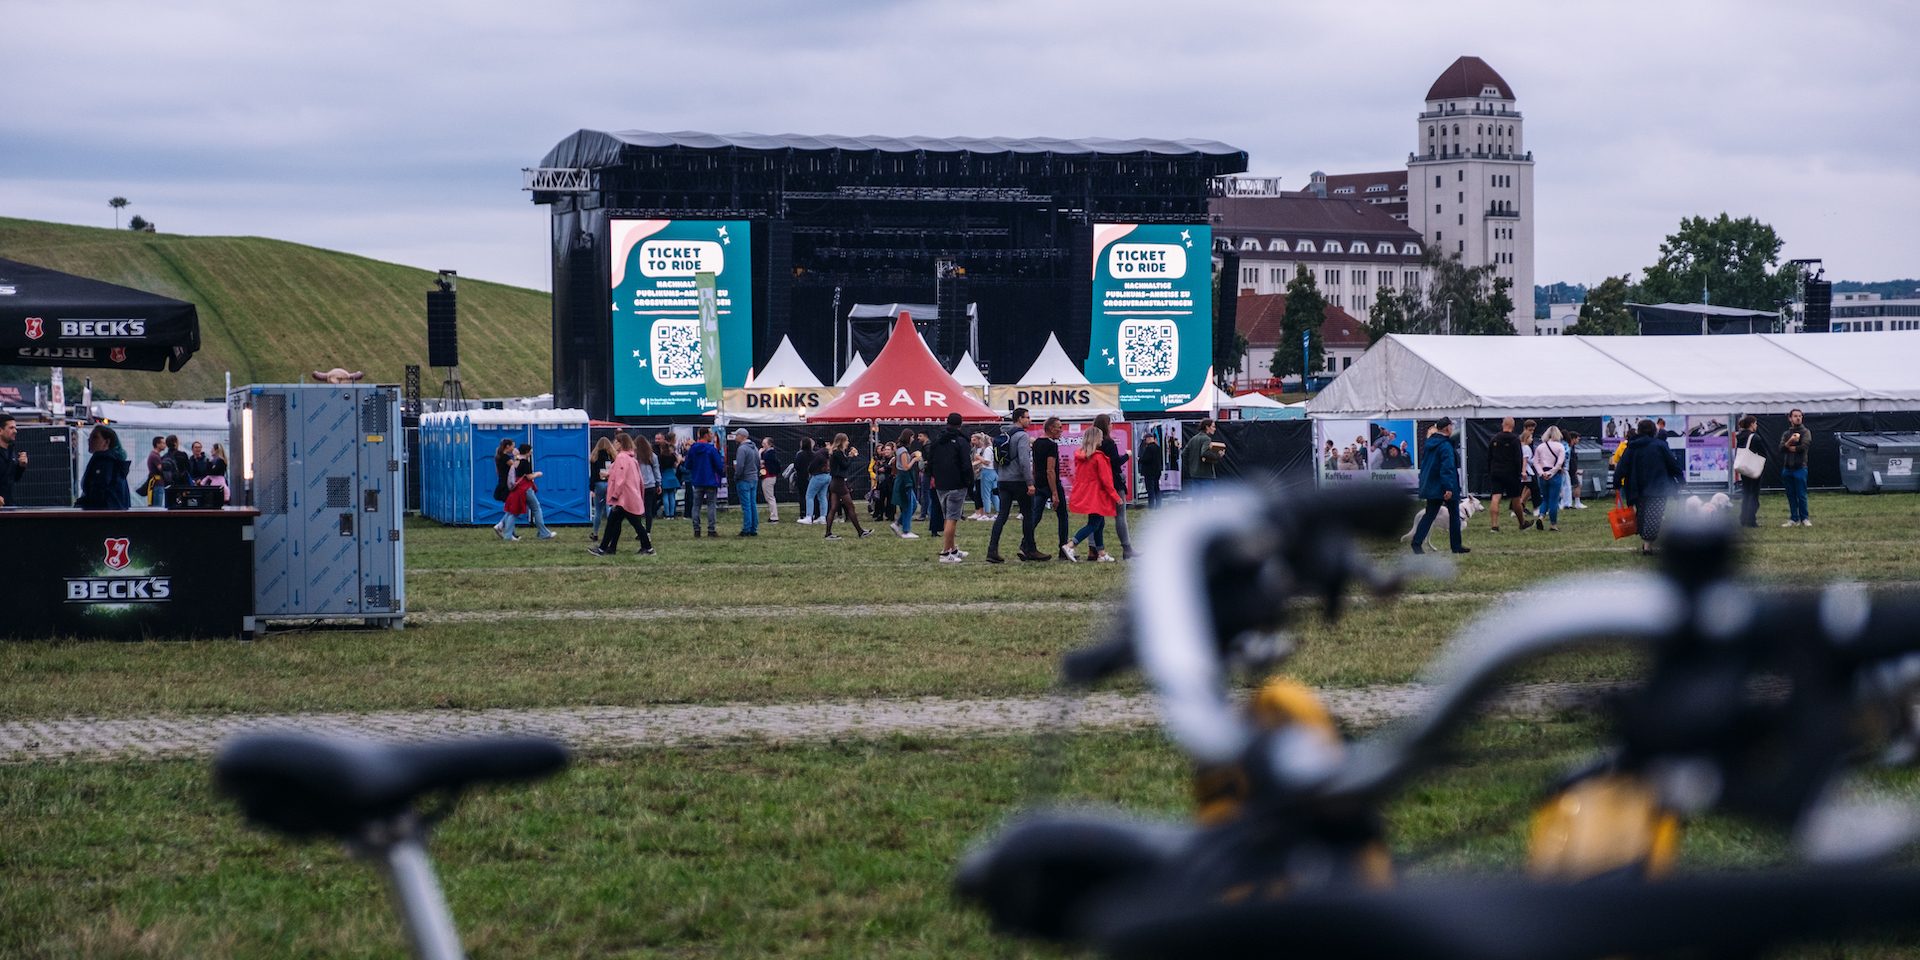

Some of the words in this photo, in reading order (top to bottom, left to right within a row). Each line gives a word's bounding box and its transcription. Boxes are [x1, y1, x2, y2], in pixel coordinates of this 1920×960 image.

[648, 247, 701, 258] TICKET
[1116, 250, 1166, 261] TICKET
[648, 260, 666, 270] TO
[671, 260, 701, 270] RIDE
[1116, 262, 1134, 272] TO
[1138, 262, 1166, 272] RIDE
[656, 280, 697, 288] NACHHALT
[60, 319, 145, 336] BECK'S
[746, 393, 819, 408] DRINKS
[858, 389, 948, 408] BAR
[1018, 390, 1091, 406] DRINKS
[1371, 471, 1396, 480] Provinz
[67, 577, 170, 599] BECK'S
